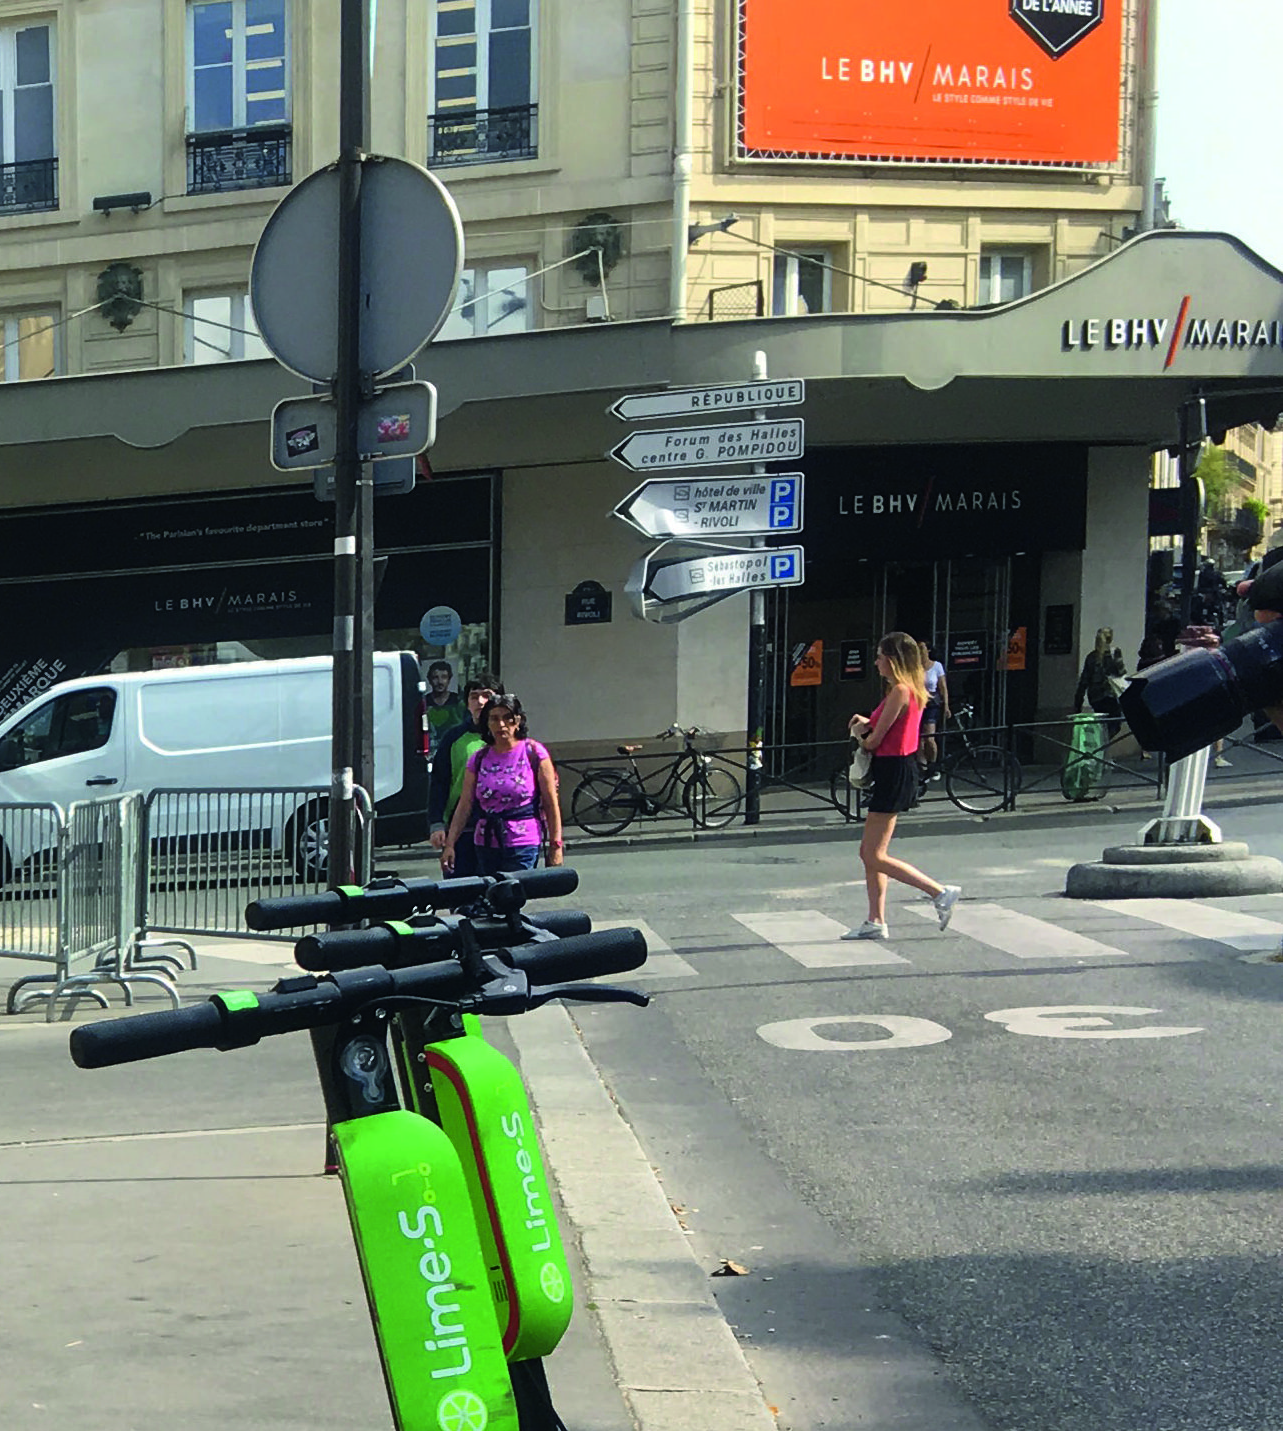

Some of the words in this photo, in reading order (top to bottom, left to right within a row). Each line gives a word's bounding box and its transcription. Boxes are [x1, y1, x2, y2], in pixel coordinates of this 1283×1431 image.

[821, 57, 851, 82] LE
[932, 63, 1034, 91] MARAIS
[932, 93, 942, 103] LE
[944, 94, 969, 103] STYLE
[1002, 96, 1026, 106] STYLE
[1028, 97, 1039, 107] DE
[1068, 319, 1100, 345] LE
[691, 386, 796, 407] RÉPUBLIQUE
[665, 435, 710, 447] Forum
[718, 432, 742, 443] des
[750, 428, 797, 441] Halles
[641, 450, 687, 464] centre
[718, 441, 797, 457] POMPIDOU
[694, 486, 724, 498] hôtel
[726, 485, 740, 497] de
[743, 483, 766, 495] ville
[775, 482, 791, 502] P
[839, 495, 864, 514] LE
[935, 490, 1021, 511] MARAIS
[708, 499, 758, 513] MARTIN
[774, 506, 790, 526] P
[728, 572, 766, 584] Halles
[775, 558, 790, 578] P
[155, 600, 174, 611] LE
[228, 590, 297, 606] MARAIS
